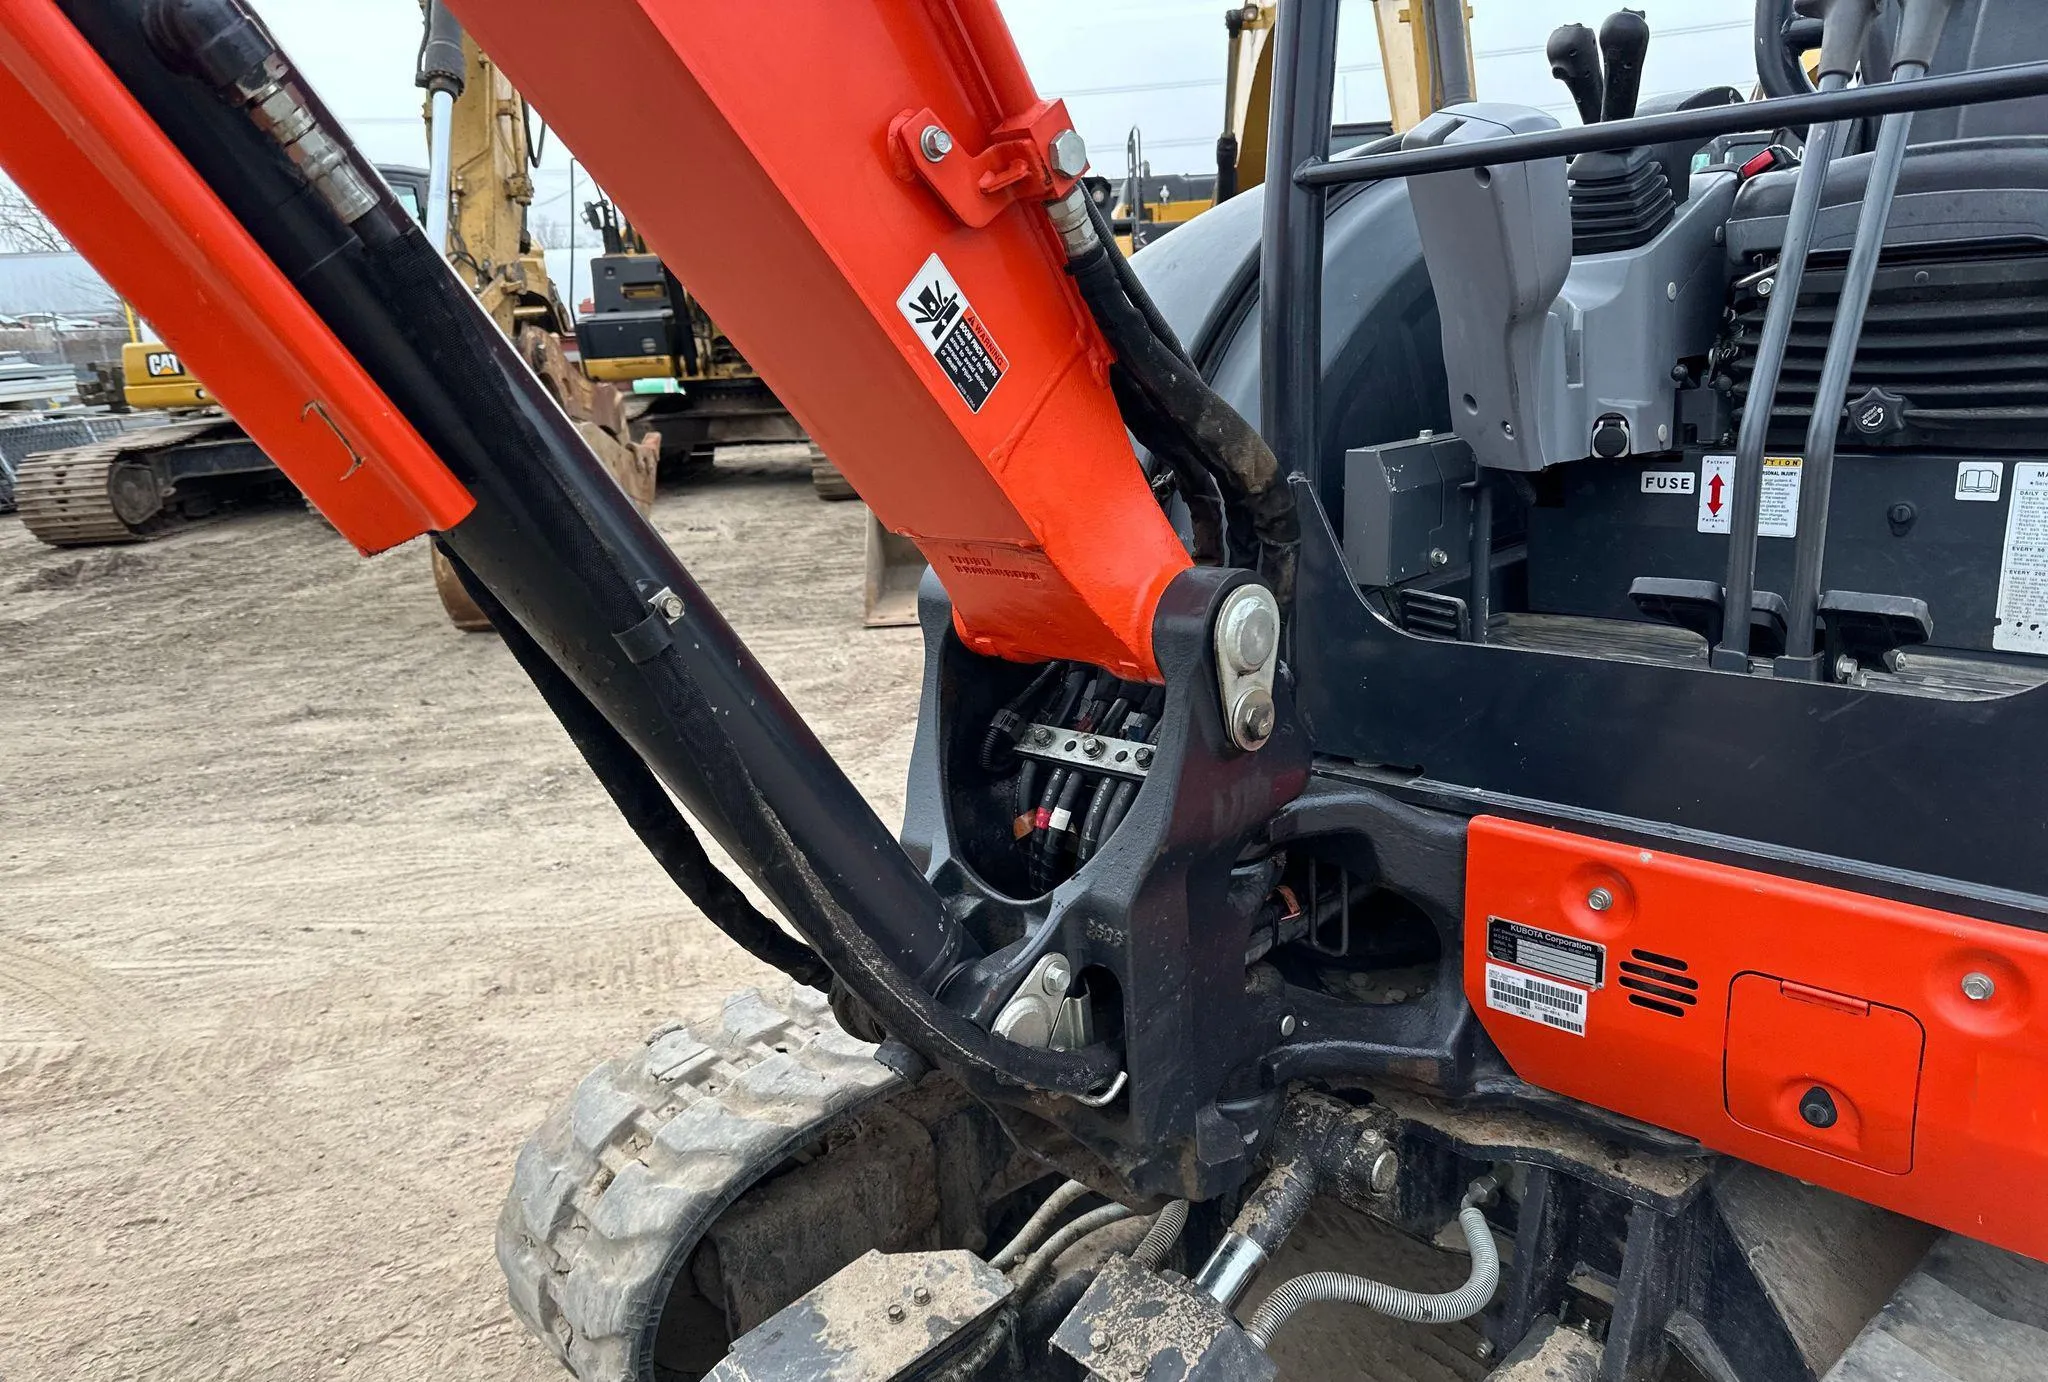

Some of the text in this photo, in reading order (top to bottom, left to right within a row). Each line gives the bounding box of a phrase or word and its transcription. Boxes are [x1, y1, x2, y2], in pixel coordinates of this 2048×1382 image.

[940, 348, 946, 356] or
[954, 329, 985, 373] Keep out of this
[959, 321, 973, 340] BOOM
[971, 338, 984, 356] PINCH
[975, 323, 1003, 366] WARNING
[148, 354, 180, 376] CAT
[944, 342, 963, 367] personal
[961, 366, 974, 383] injury
[949, 336, 960, 350] area
[963, 356, 976, 372] avoid
[974, 372, 988, 391] serious
[1645, 477, 1691, 490] FUSE
[1510, 924, 1544, 940] KUBOTA
[1544, 933, 1592, 952] Corporation
